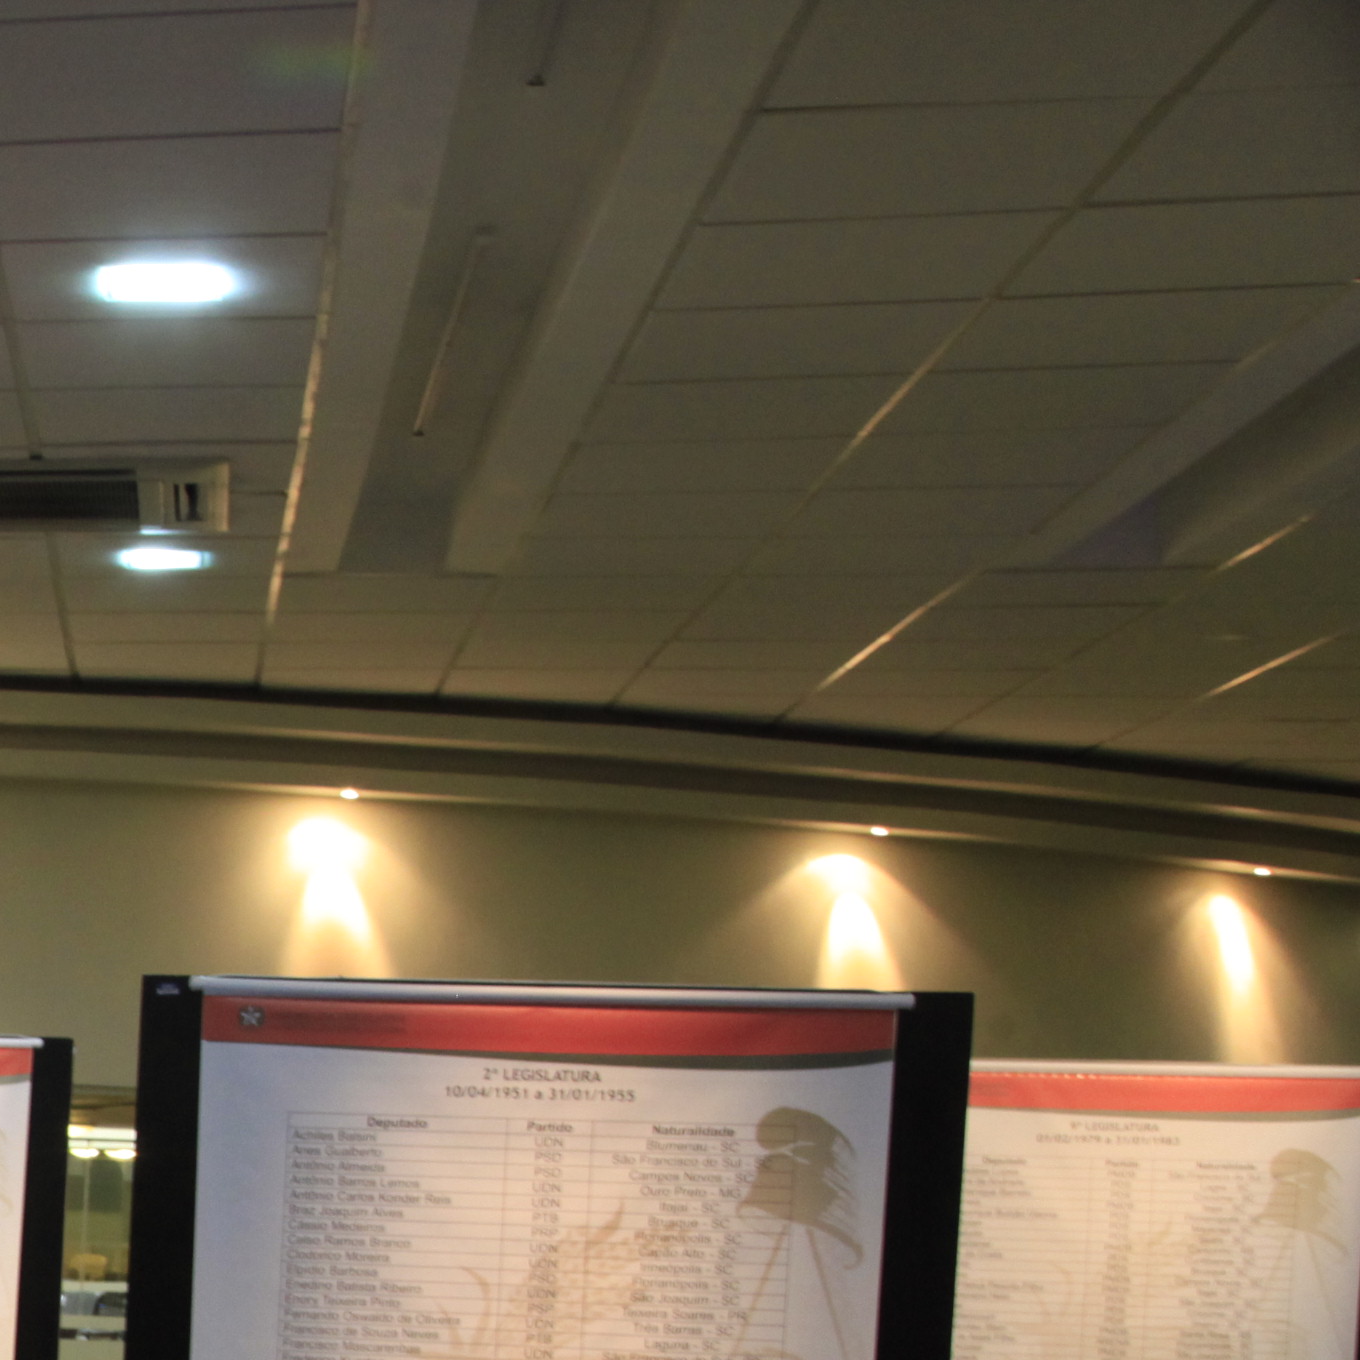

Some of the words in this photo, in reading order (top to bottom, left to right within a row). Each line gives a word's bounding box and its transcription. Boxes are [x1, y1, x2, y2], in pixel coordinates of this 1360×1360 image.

[503, 1067, 602, 1083] LEGISLATURA
[445, 1085, 530, 1099] 10/04/1951
[549, 1087, 636, 1102] 31/01/1955
[366, 1116, 428, 1130] Deputado
[526, 1120, 573, 1132] Partido
[651, 1124, 735, 1136] Naturalidade
